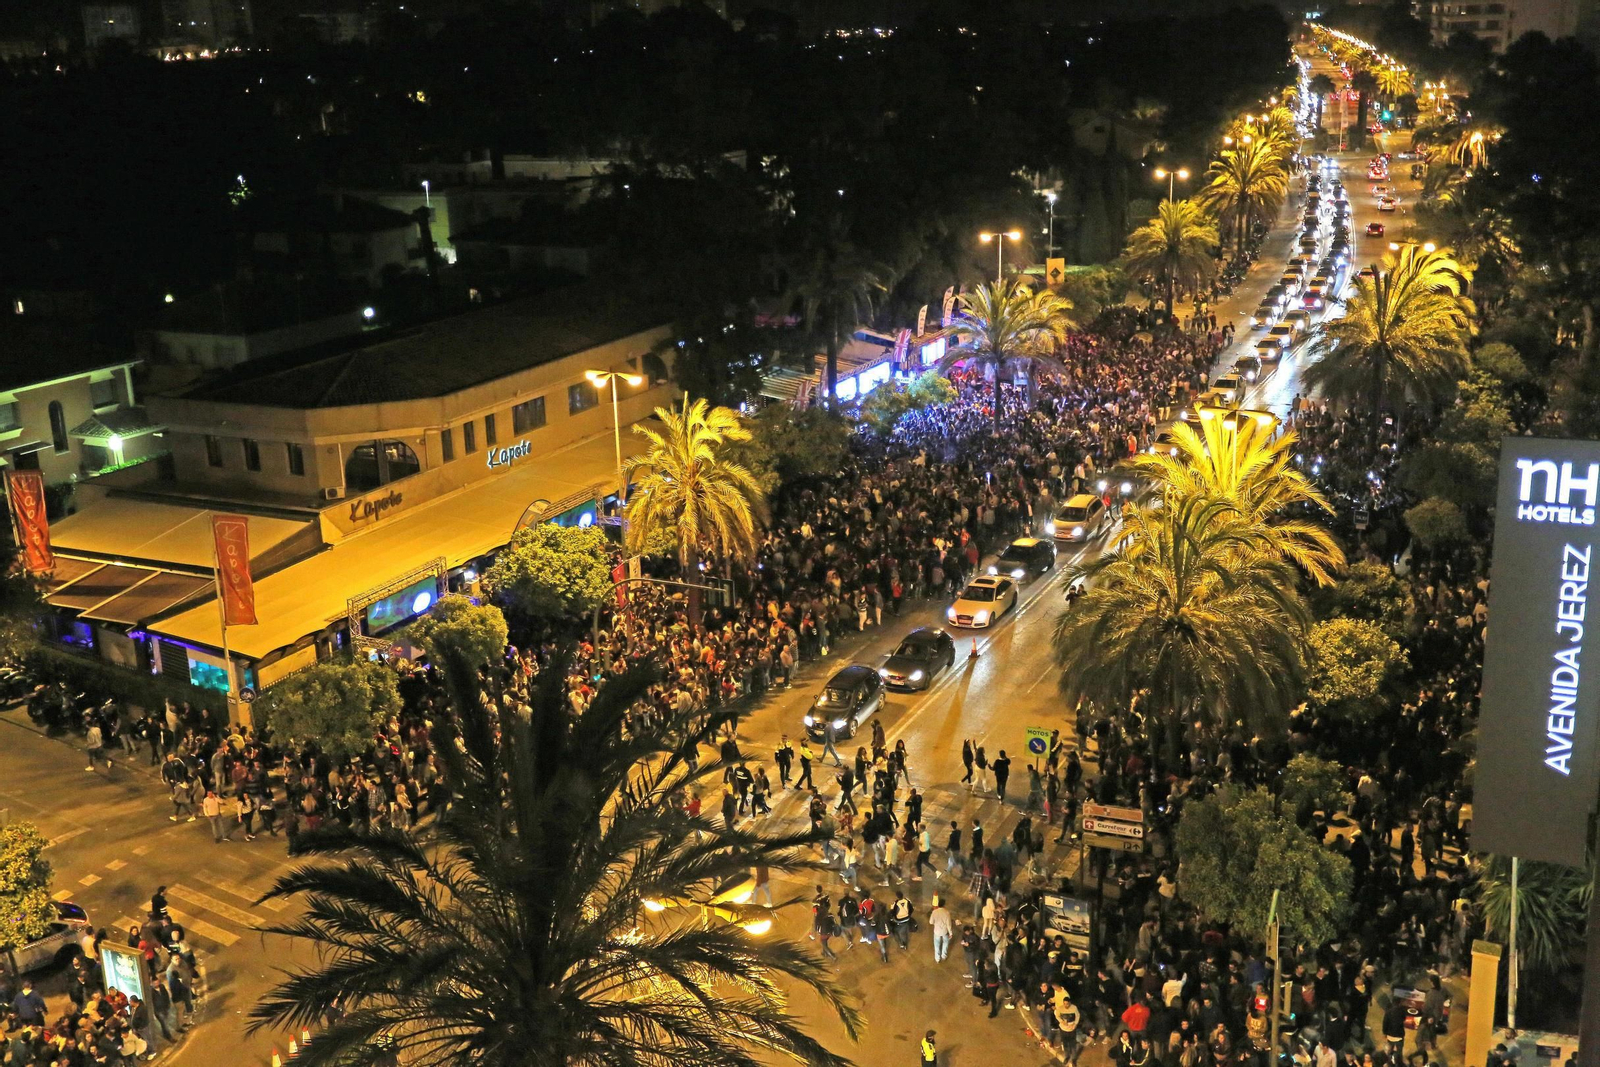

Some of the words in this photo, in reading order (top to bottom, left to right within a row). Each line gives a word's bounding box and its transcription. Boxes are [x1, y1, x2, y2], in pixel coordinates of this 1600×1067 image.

[487, 439, 532, 469] Kapote
[349, 490, 403, 523] Kapote
[1518, 504, 1595, 525] HOTELS
[1556, 543, 1592, 643] JEREZ
[1544, 646, 1582, 776] AVENIDA
[1027, 729, 1049, 737] MOTOS
[1097, 822, 1127, 831] Carrefour
